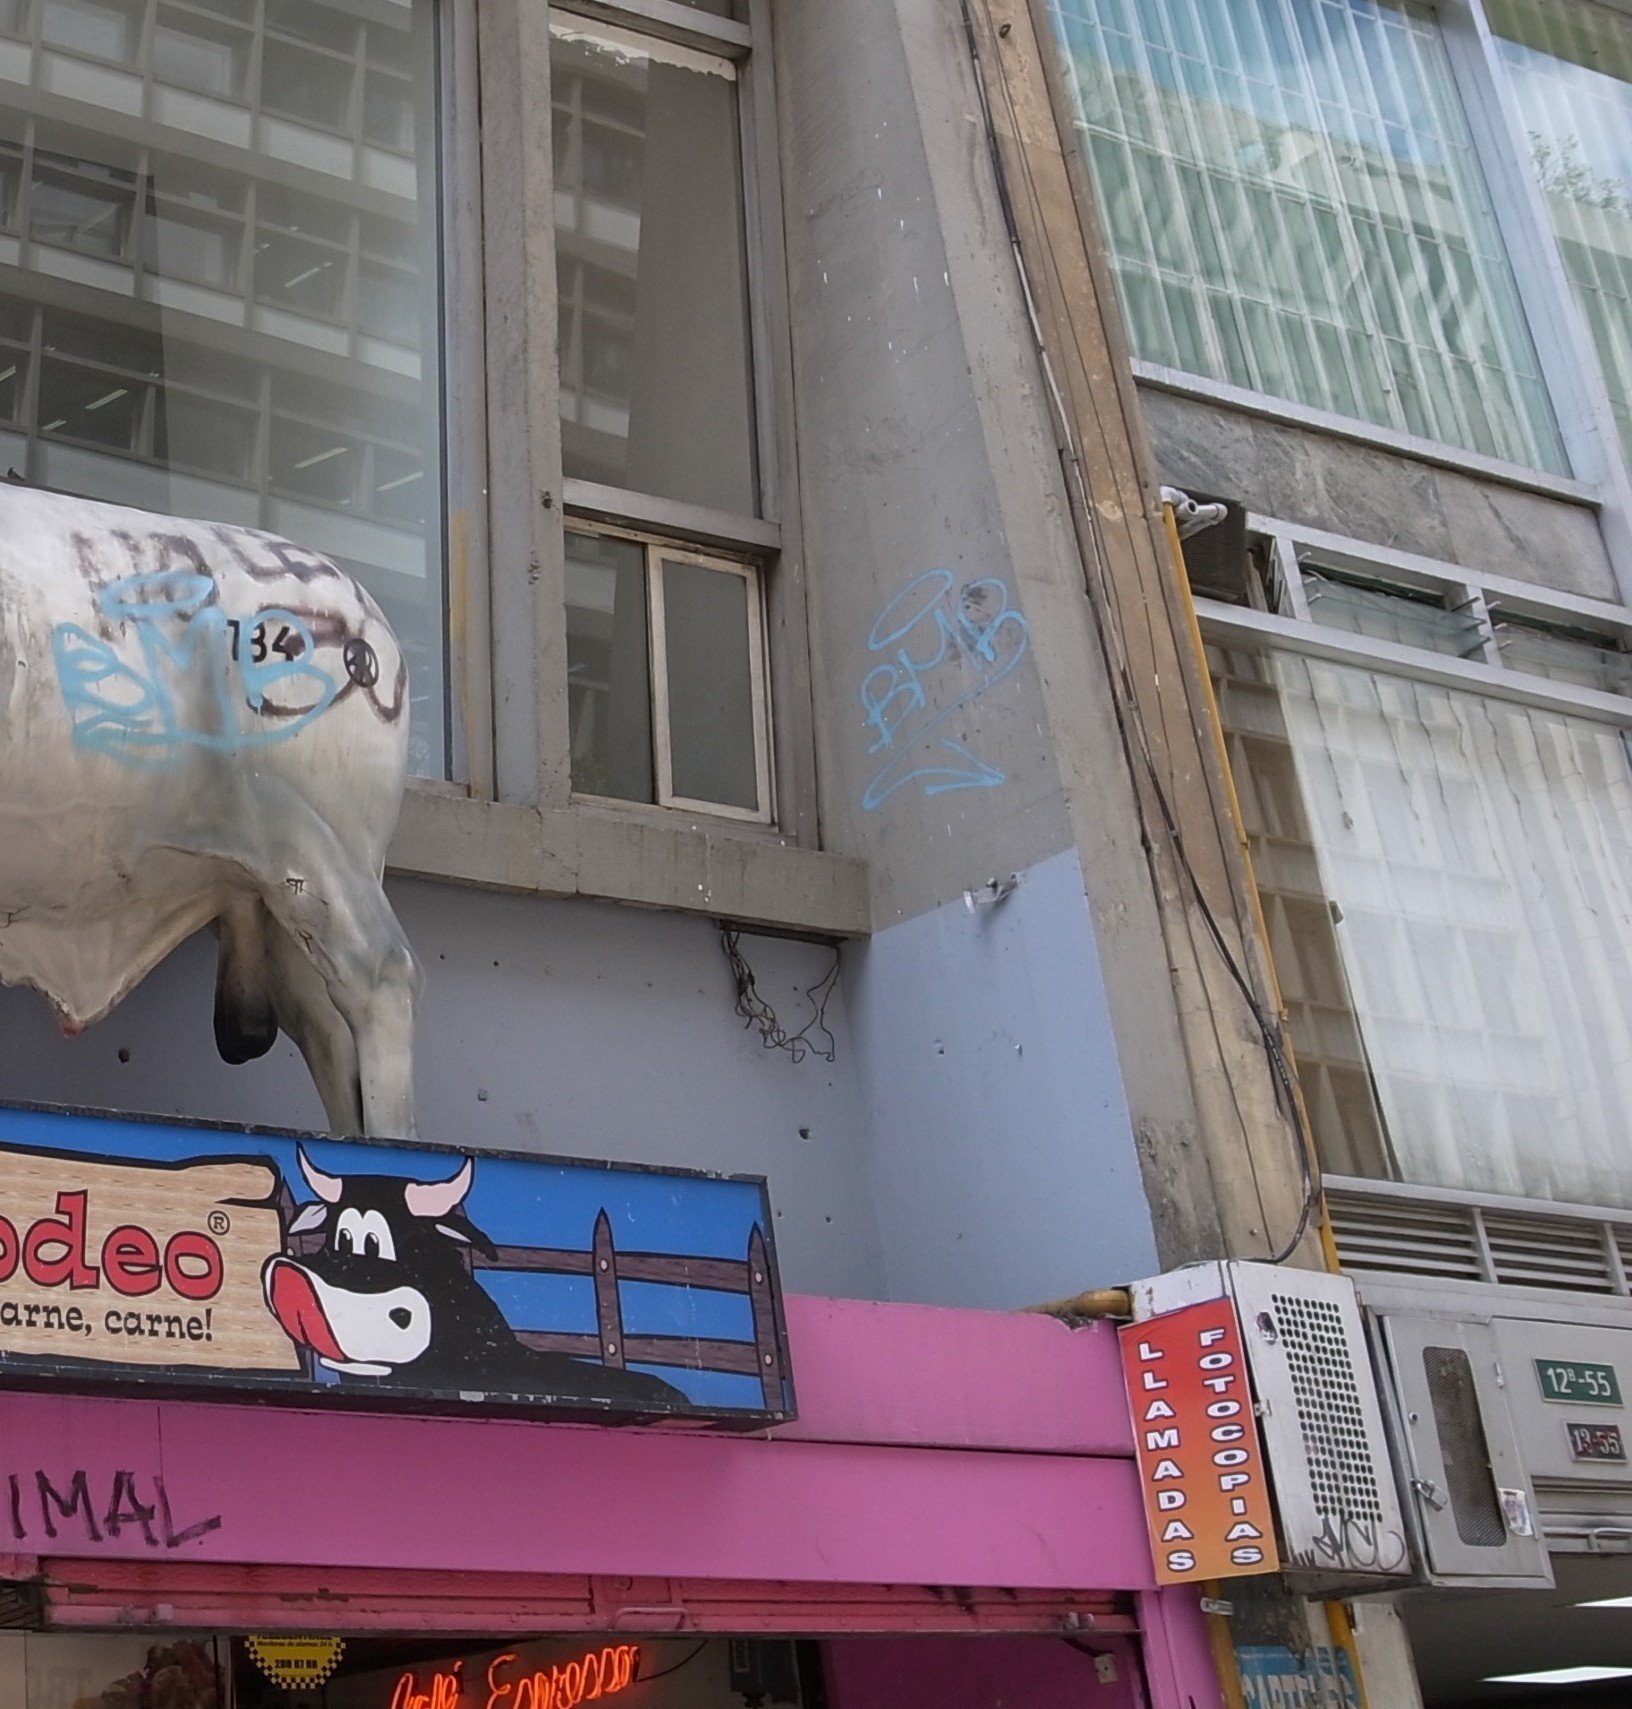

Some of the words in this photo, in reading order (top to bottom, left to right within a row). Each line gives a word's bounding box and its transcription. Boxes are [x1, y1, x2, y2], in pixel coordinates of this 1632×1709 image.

[103, 1306, 215, 1342] carne!
[1138, 1342, 1196, 1573] LLAMADAS
[1197, 1326, 1264, 1567] FOTOCOPIAS
[1573, 1428, 1621, 1455] 13-55
